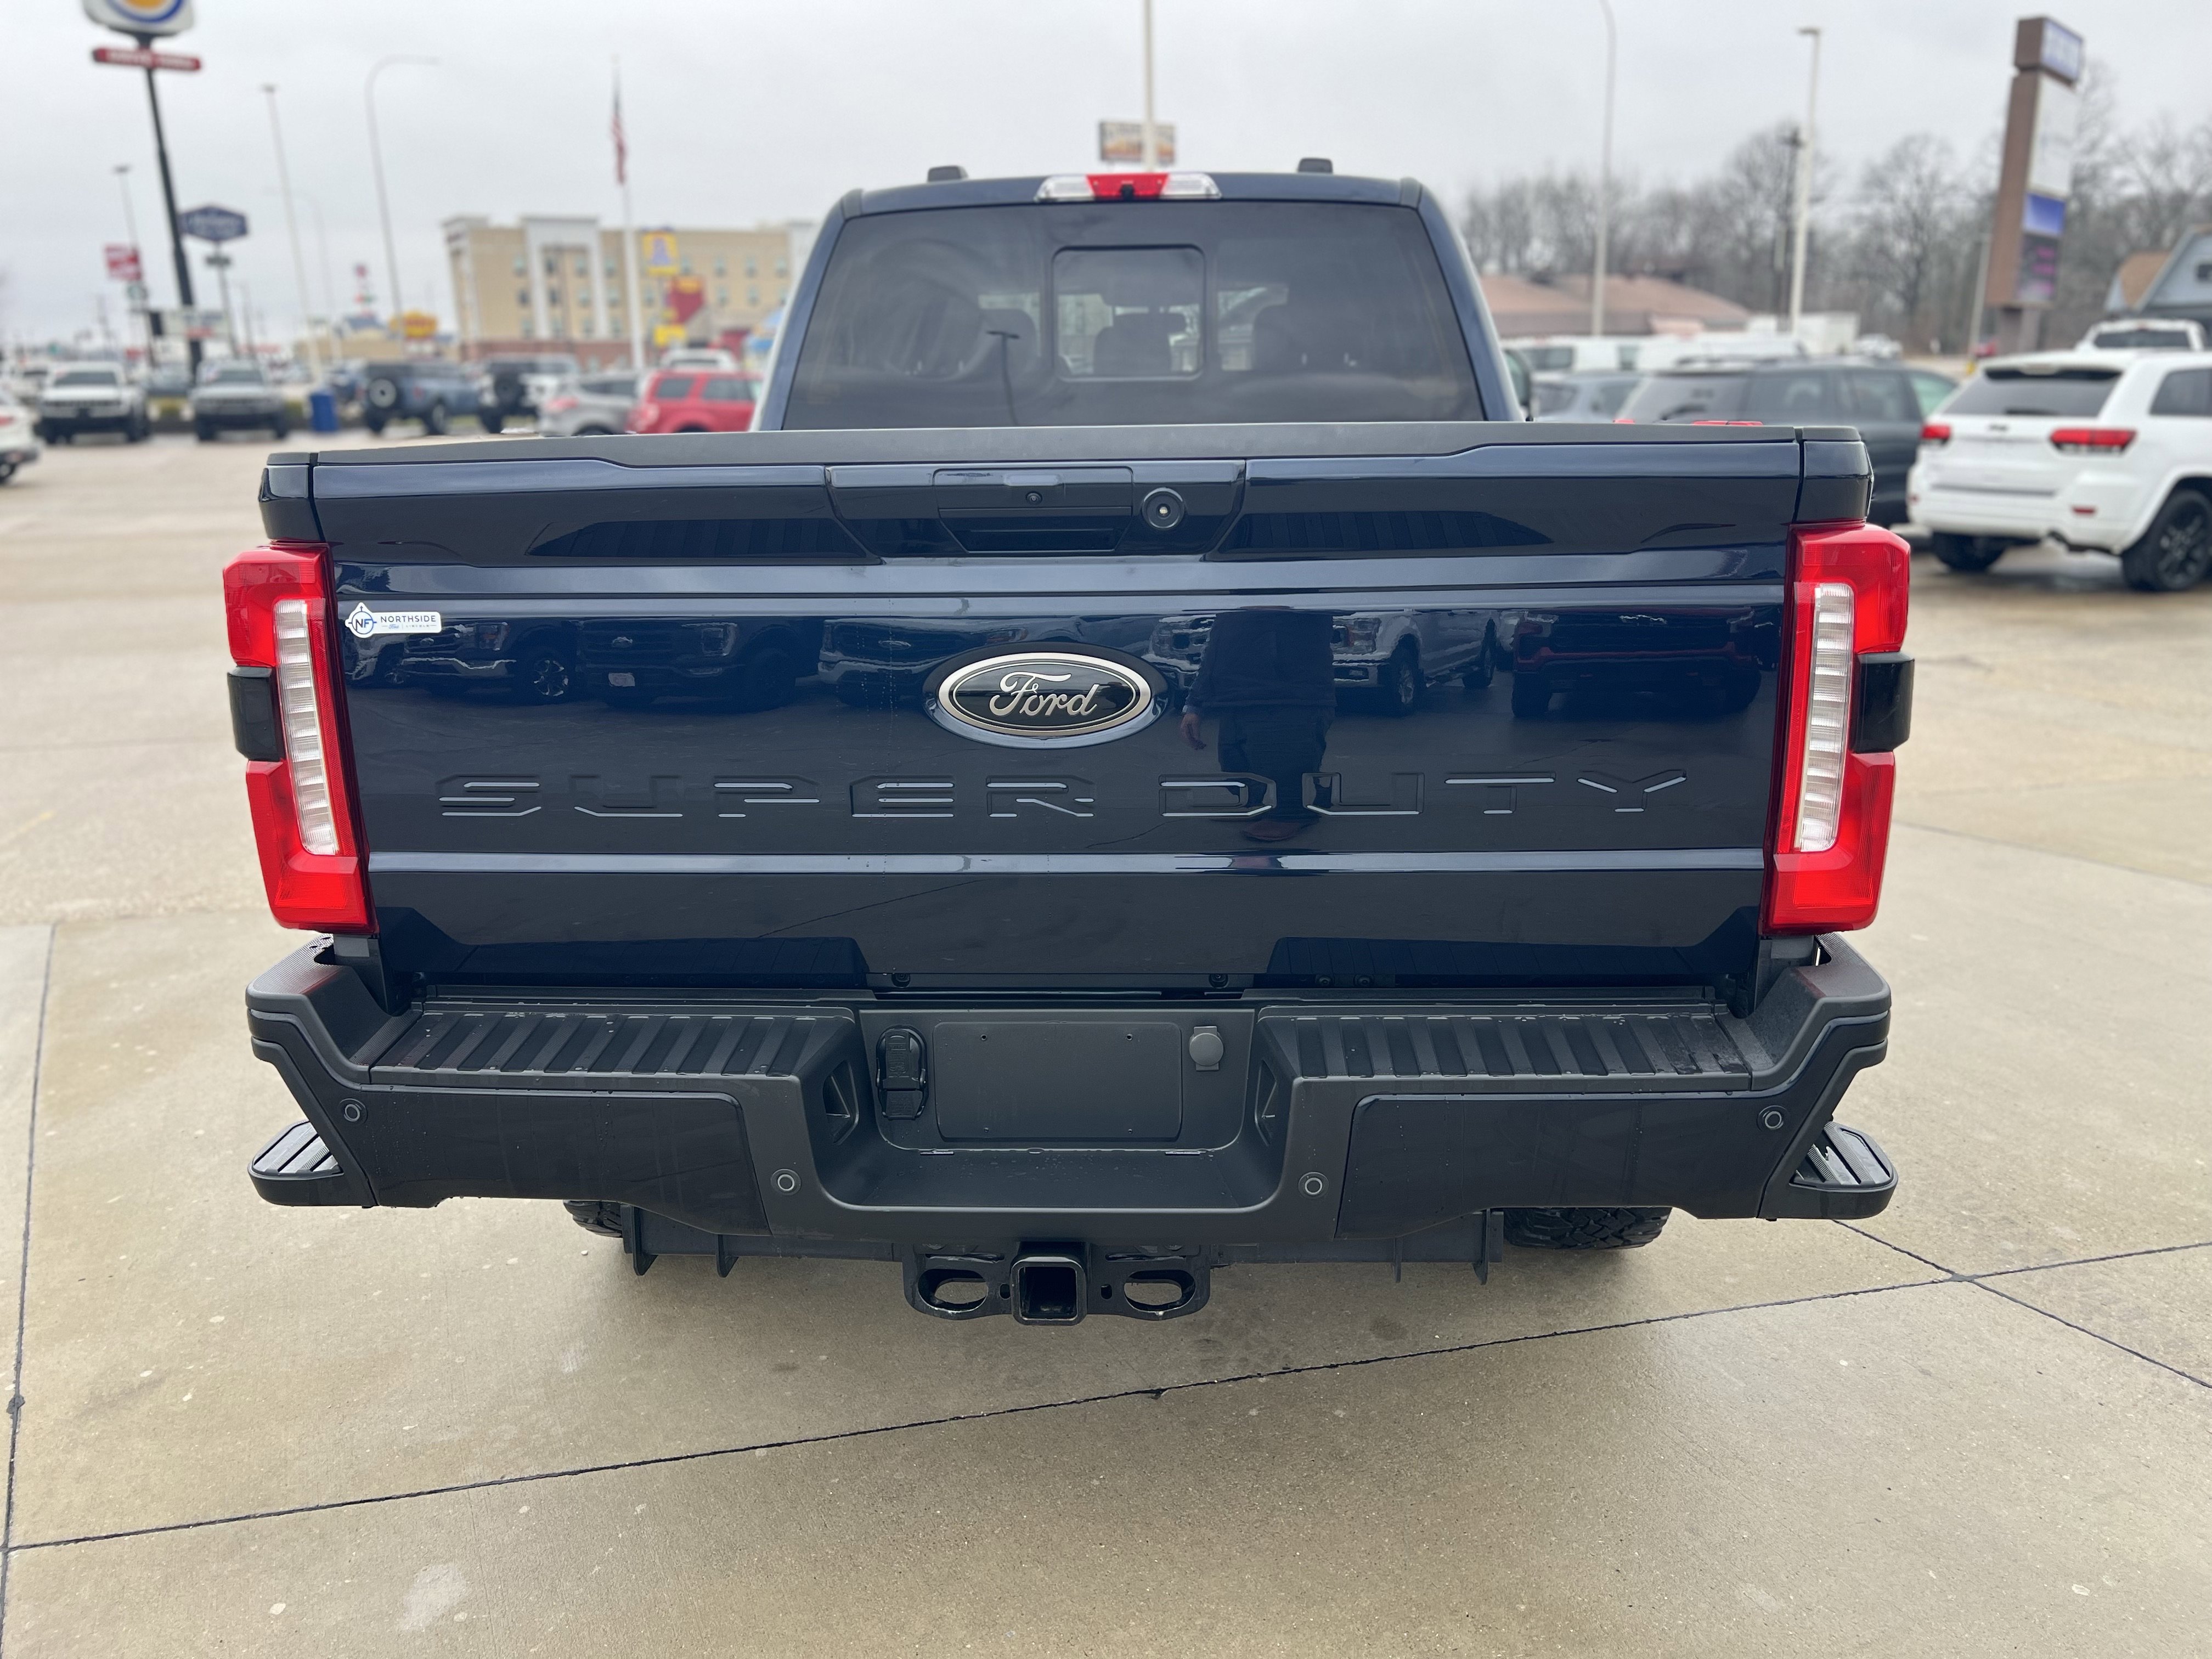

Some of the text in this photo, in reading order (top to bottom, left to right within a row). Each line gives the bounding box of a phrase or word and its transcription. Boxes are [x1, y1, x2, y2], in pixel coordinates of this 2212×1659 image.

[355, 618, 373, 631] NF
[989, 671, 1100, 717] Ford
[436, 770, 1687, 819] SUPER DUTY
